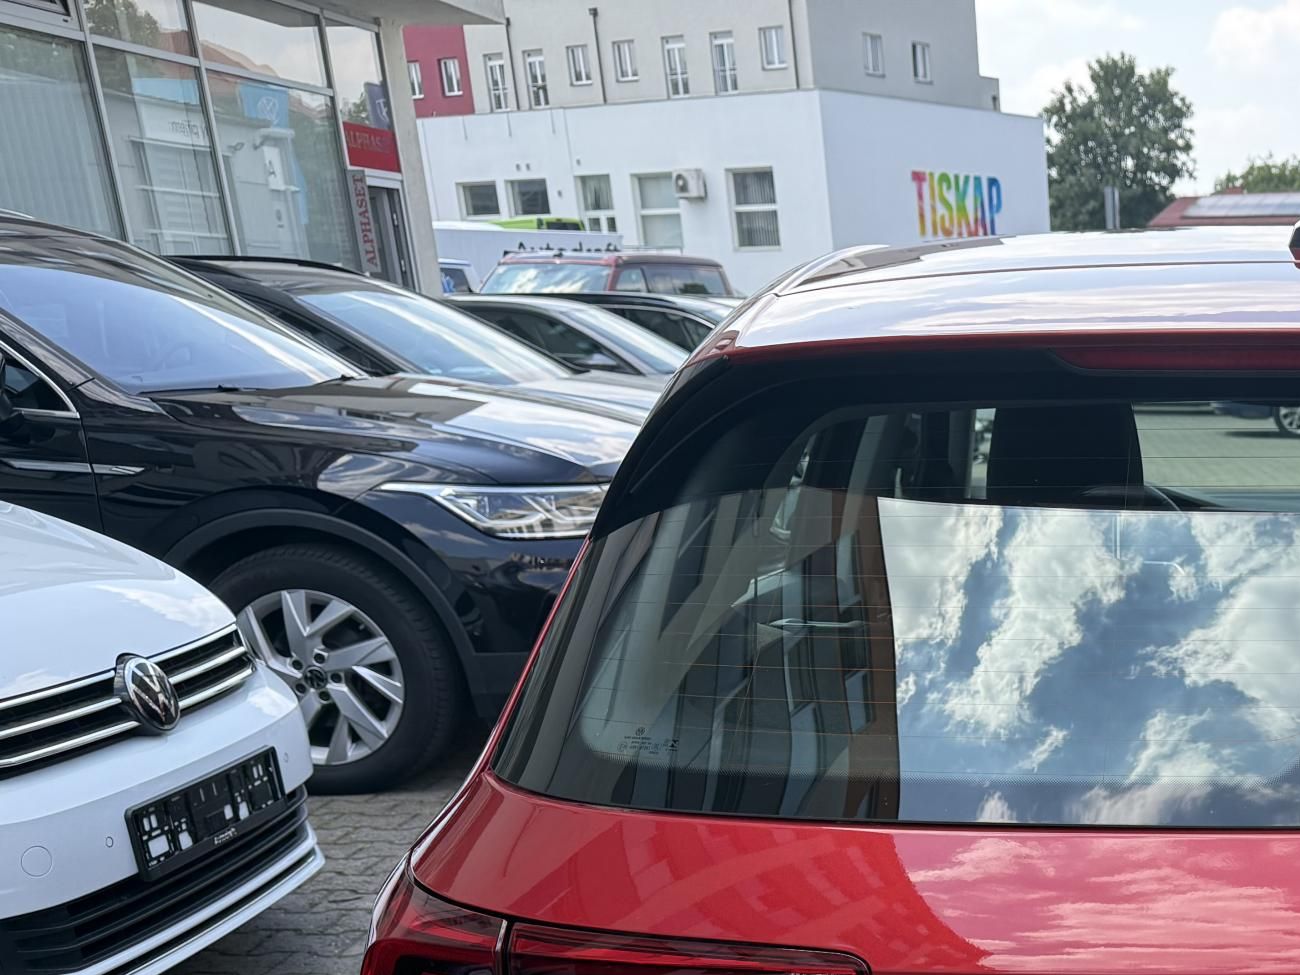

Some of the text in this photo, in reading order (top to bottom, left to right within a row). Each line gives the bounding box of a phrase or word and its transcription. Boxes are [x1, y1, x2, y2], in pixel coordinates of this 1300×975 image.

[345, 128, 396, 153] ALPHAS
[352, 174, 378, 268] ALPHASET
[911, 170, 1002, 237] TISKAP
